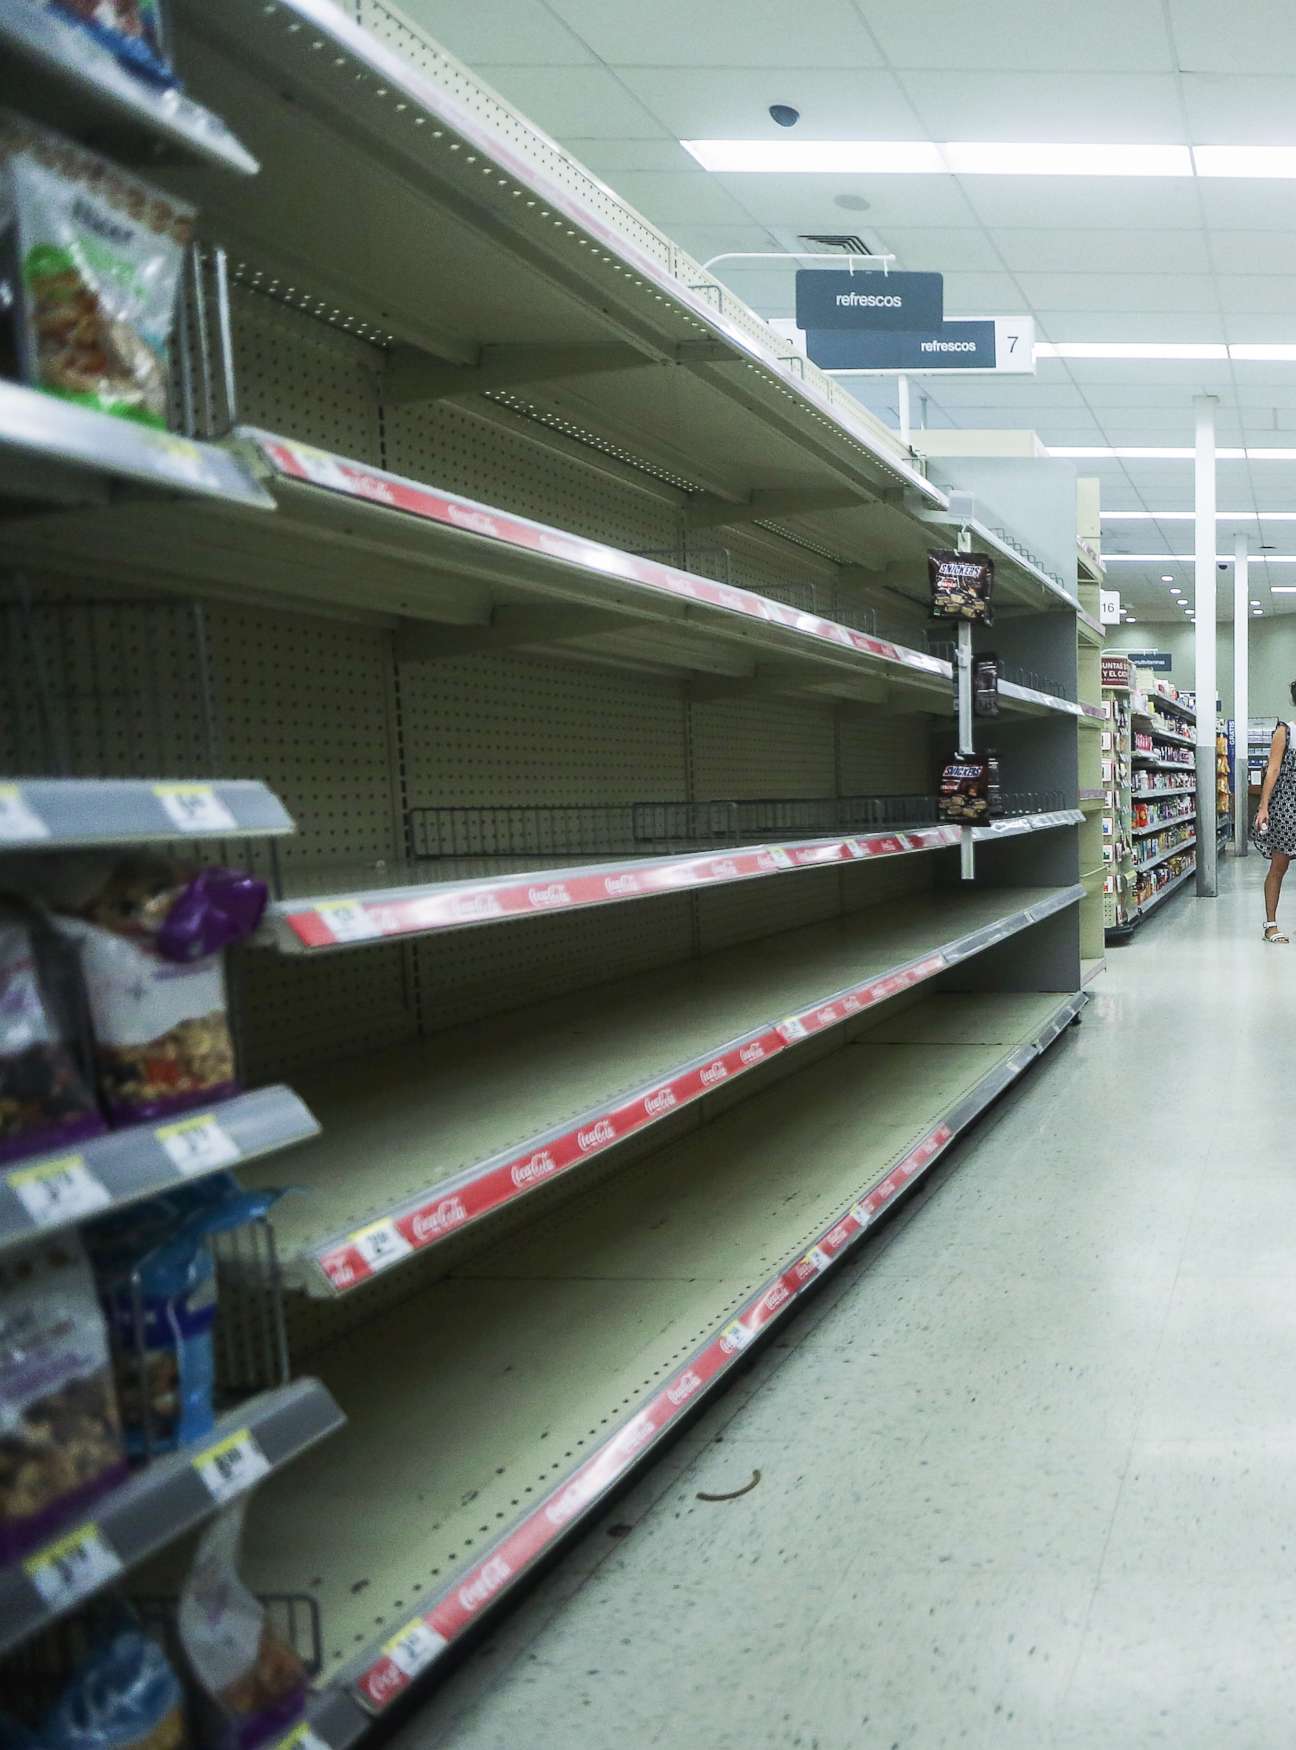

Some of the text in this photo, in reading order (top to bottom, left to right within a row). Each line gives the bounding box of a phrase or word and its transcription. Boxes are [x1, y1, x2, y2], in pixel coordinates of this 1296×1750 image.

[836, 292, 902, 308] refrescos
[920, 340, 976, 352] refrescos
[1007, 336, 1019, 353] 7
[939, 563, 981, 577] SNICKERS
[1102, 602, 1115, 613] 16
